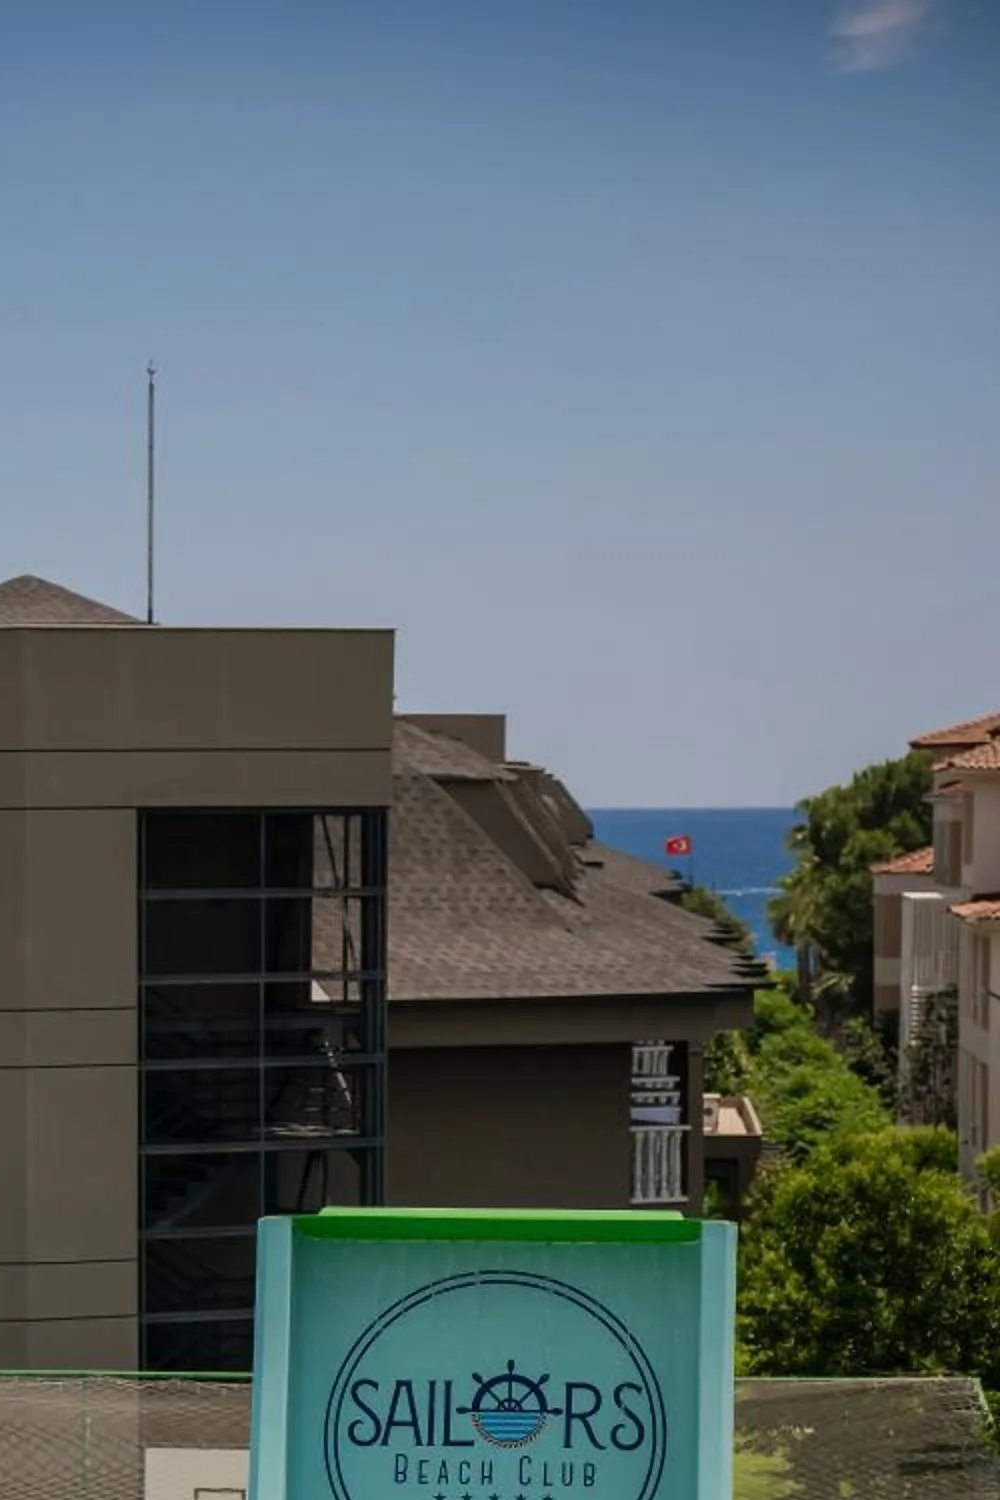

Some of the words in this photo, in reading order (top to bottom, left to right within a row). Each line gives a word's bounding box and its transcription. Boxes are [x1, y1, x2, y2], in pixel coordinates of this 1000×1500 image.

[347, 1360, 645, 1451] SAILORS
[394, 1453, 494, 1485] BEACH
[518, 1455, 597, 1488] CLUB
